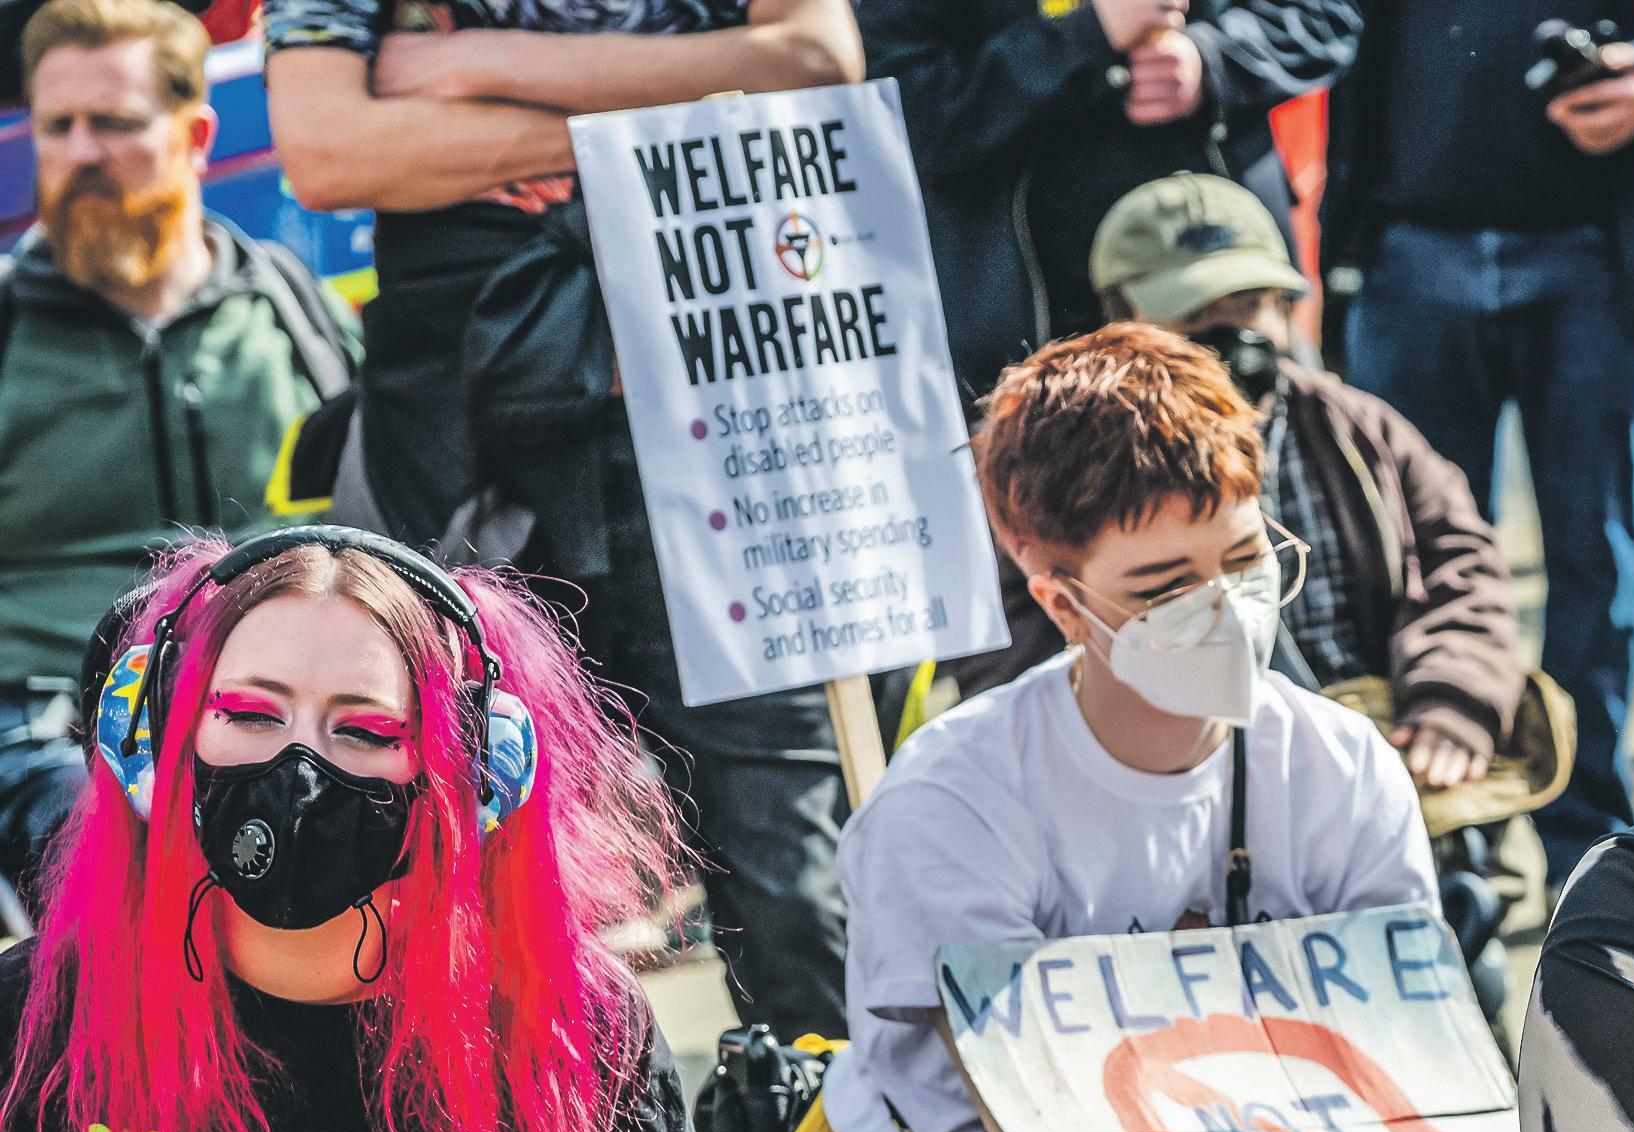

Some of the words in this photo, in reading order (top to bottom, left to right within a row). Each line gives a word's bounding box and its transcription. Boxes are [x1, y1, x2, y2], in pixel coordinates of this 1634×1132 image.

[634, 120, 858, 217] WELFARE
[654, 216, 759, 302] NOT
[671, 284, 897, 385] WARFARE
[714, 404, 770, 439] Stop
[777, 386, 854, 426] attacks
[857, 388, 885, 412] on
[724, 431, 824, 479] disabled
[828, 428, 896, 464] people
[733, 495, 770, 528] No
[772, 482, 865, 521] increase
[866, 476, 890, 504] in
[743, 531, 831, 569] military
[836, 514, 932, 553] spending
[752, 576, 824, 619] Social
[829, 566, 909, 606] security
[763, 622, 804, 661] and
[809, 619, 884, 651] homes
[887, 605, 917, 636] for
[921, 595, 949, 630] all
[942, 918, 1450, 1039] WELFARE
